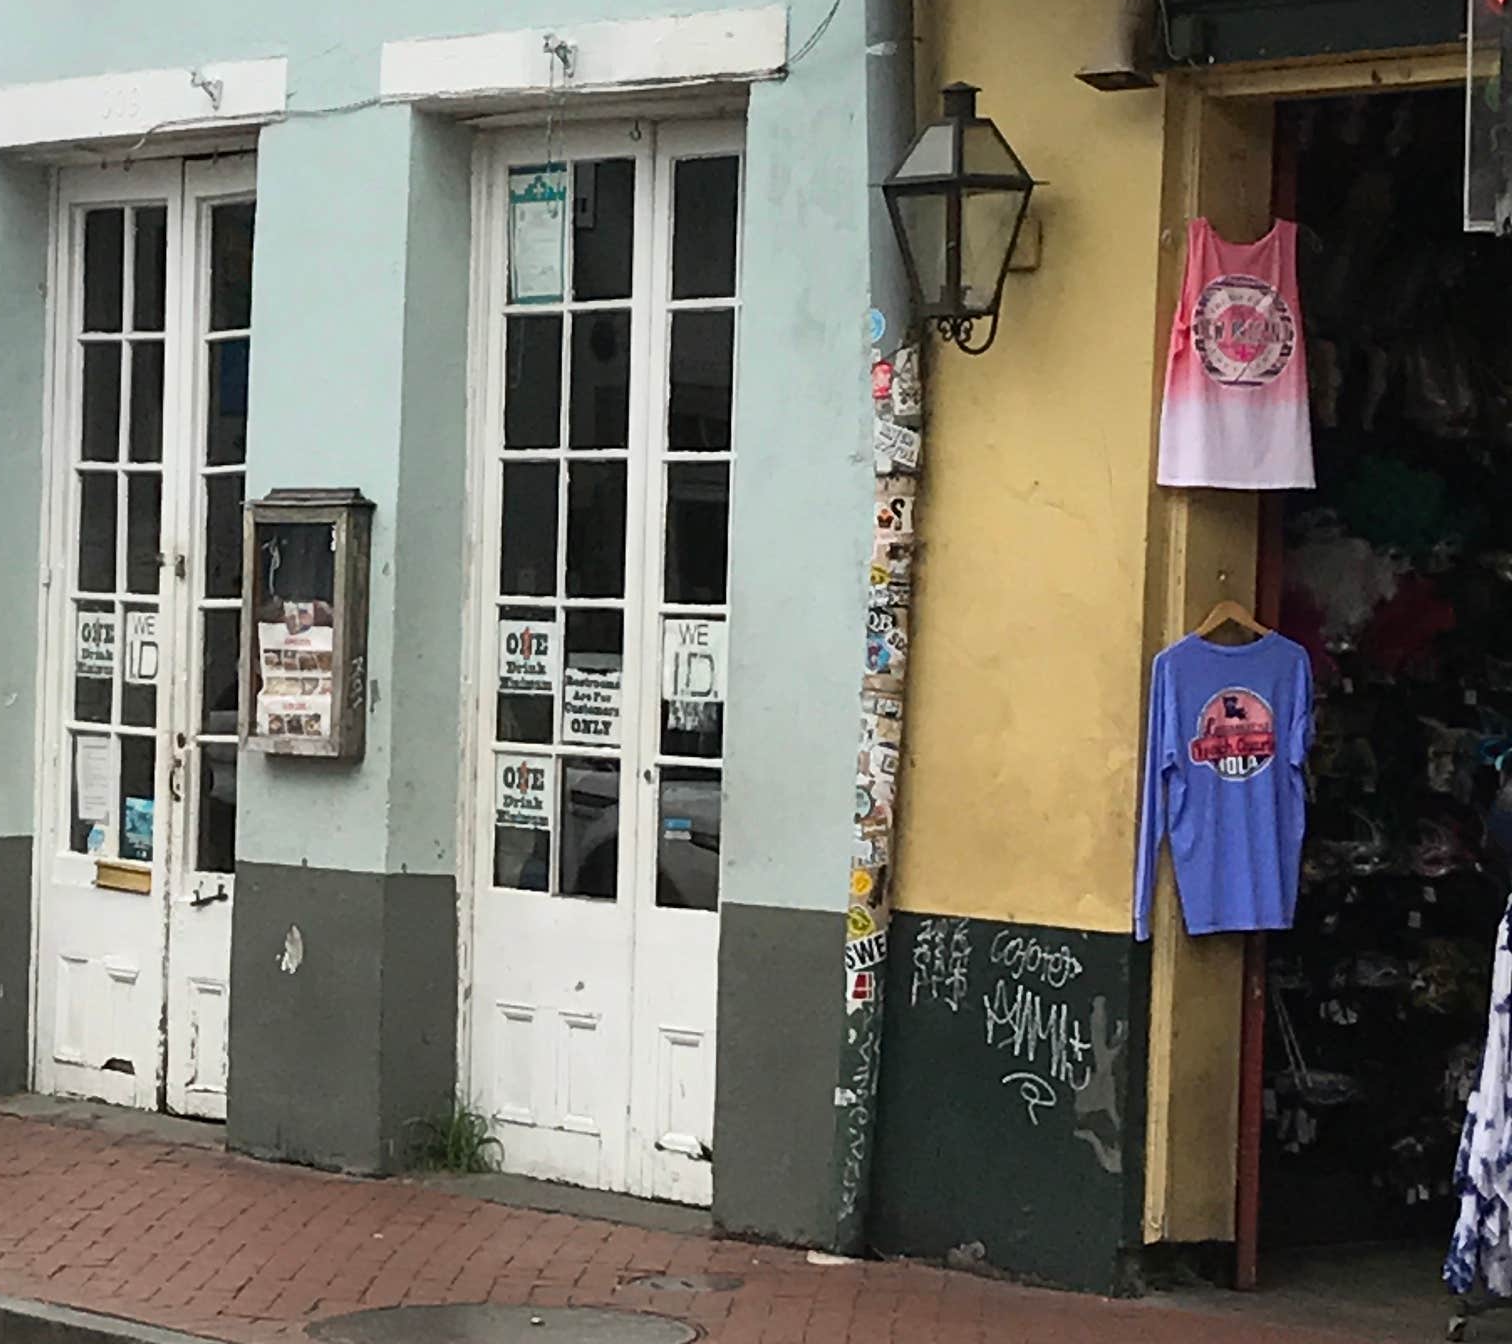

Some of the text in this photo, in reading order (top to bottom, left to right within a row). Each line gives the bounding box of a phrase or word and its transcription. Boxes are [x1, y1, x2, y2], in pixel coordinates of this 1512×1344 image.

[678, 623, 709, 646] WE
[506, 661, 547, 675] Drink
[571, 718, 612, 735] ONLY
[503, 794, 543, 810] Drink
